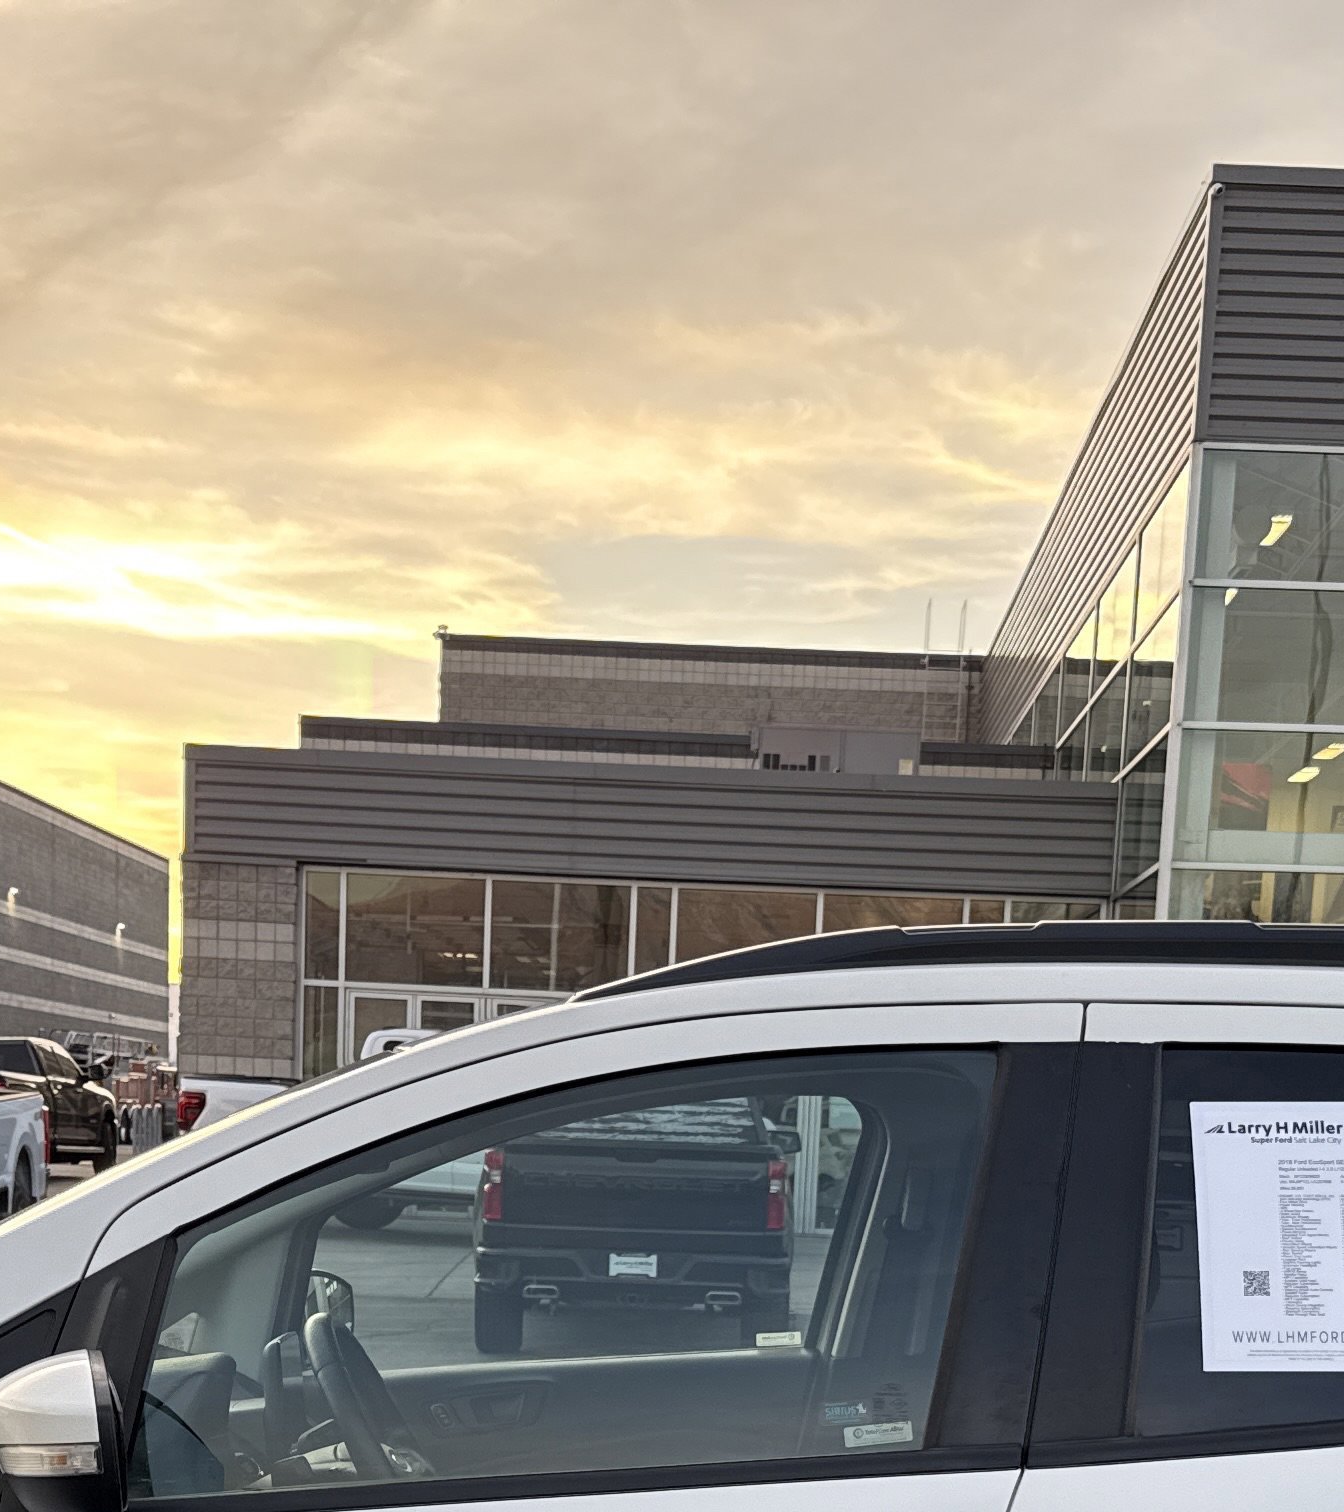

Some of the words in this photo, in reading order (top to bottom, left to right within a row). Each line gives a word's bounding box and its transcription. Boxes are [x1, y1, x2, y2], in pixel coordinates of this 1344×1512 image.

[1227, 1121, 1273, 1137] Larry
[1276, 1121, 1289, 1134] H
[1292, 1120, 1344, 1135] Miller
[1250, 1136, 1273, 1145] Super
[1274, 1136, 1293, 1144] Ford
[1308, 1136, 1326, 1144] Lake
[1326, 1136, 1342, 1145] City
